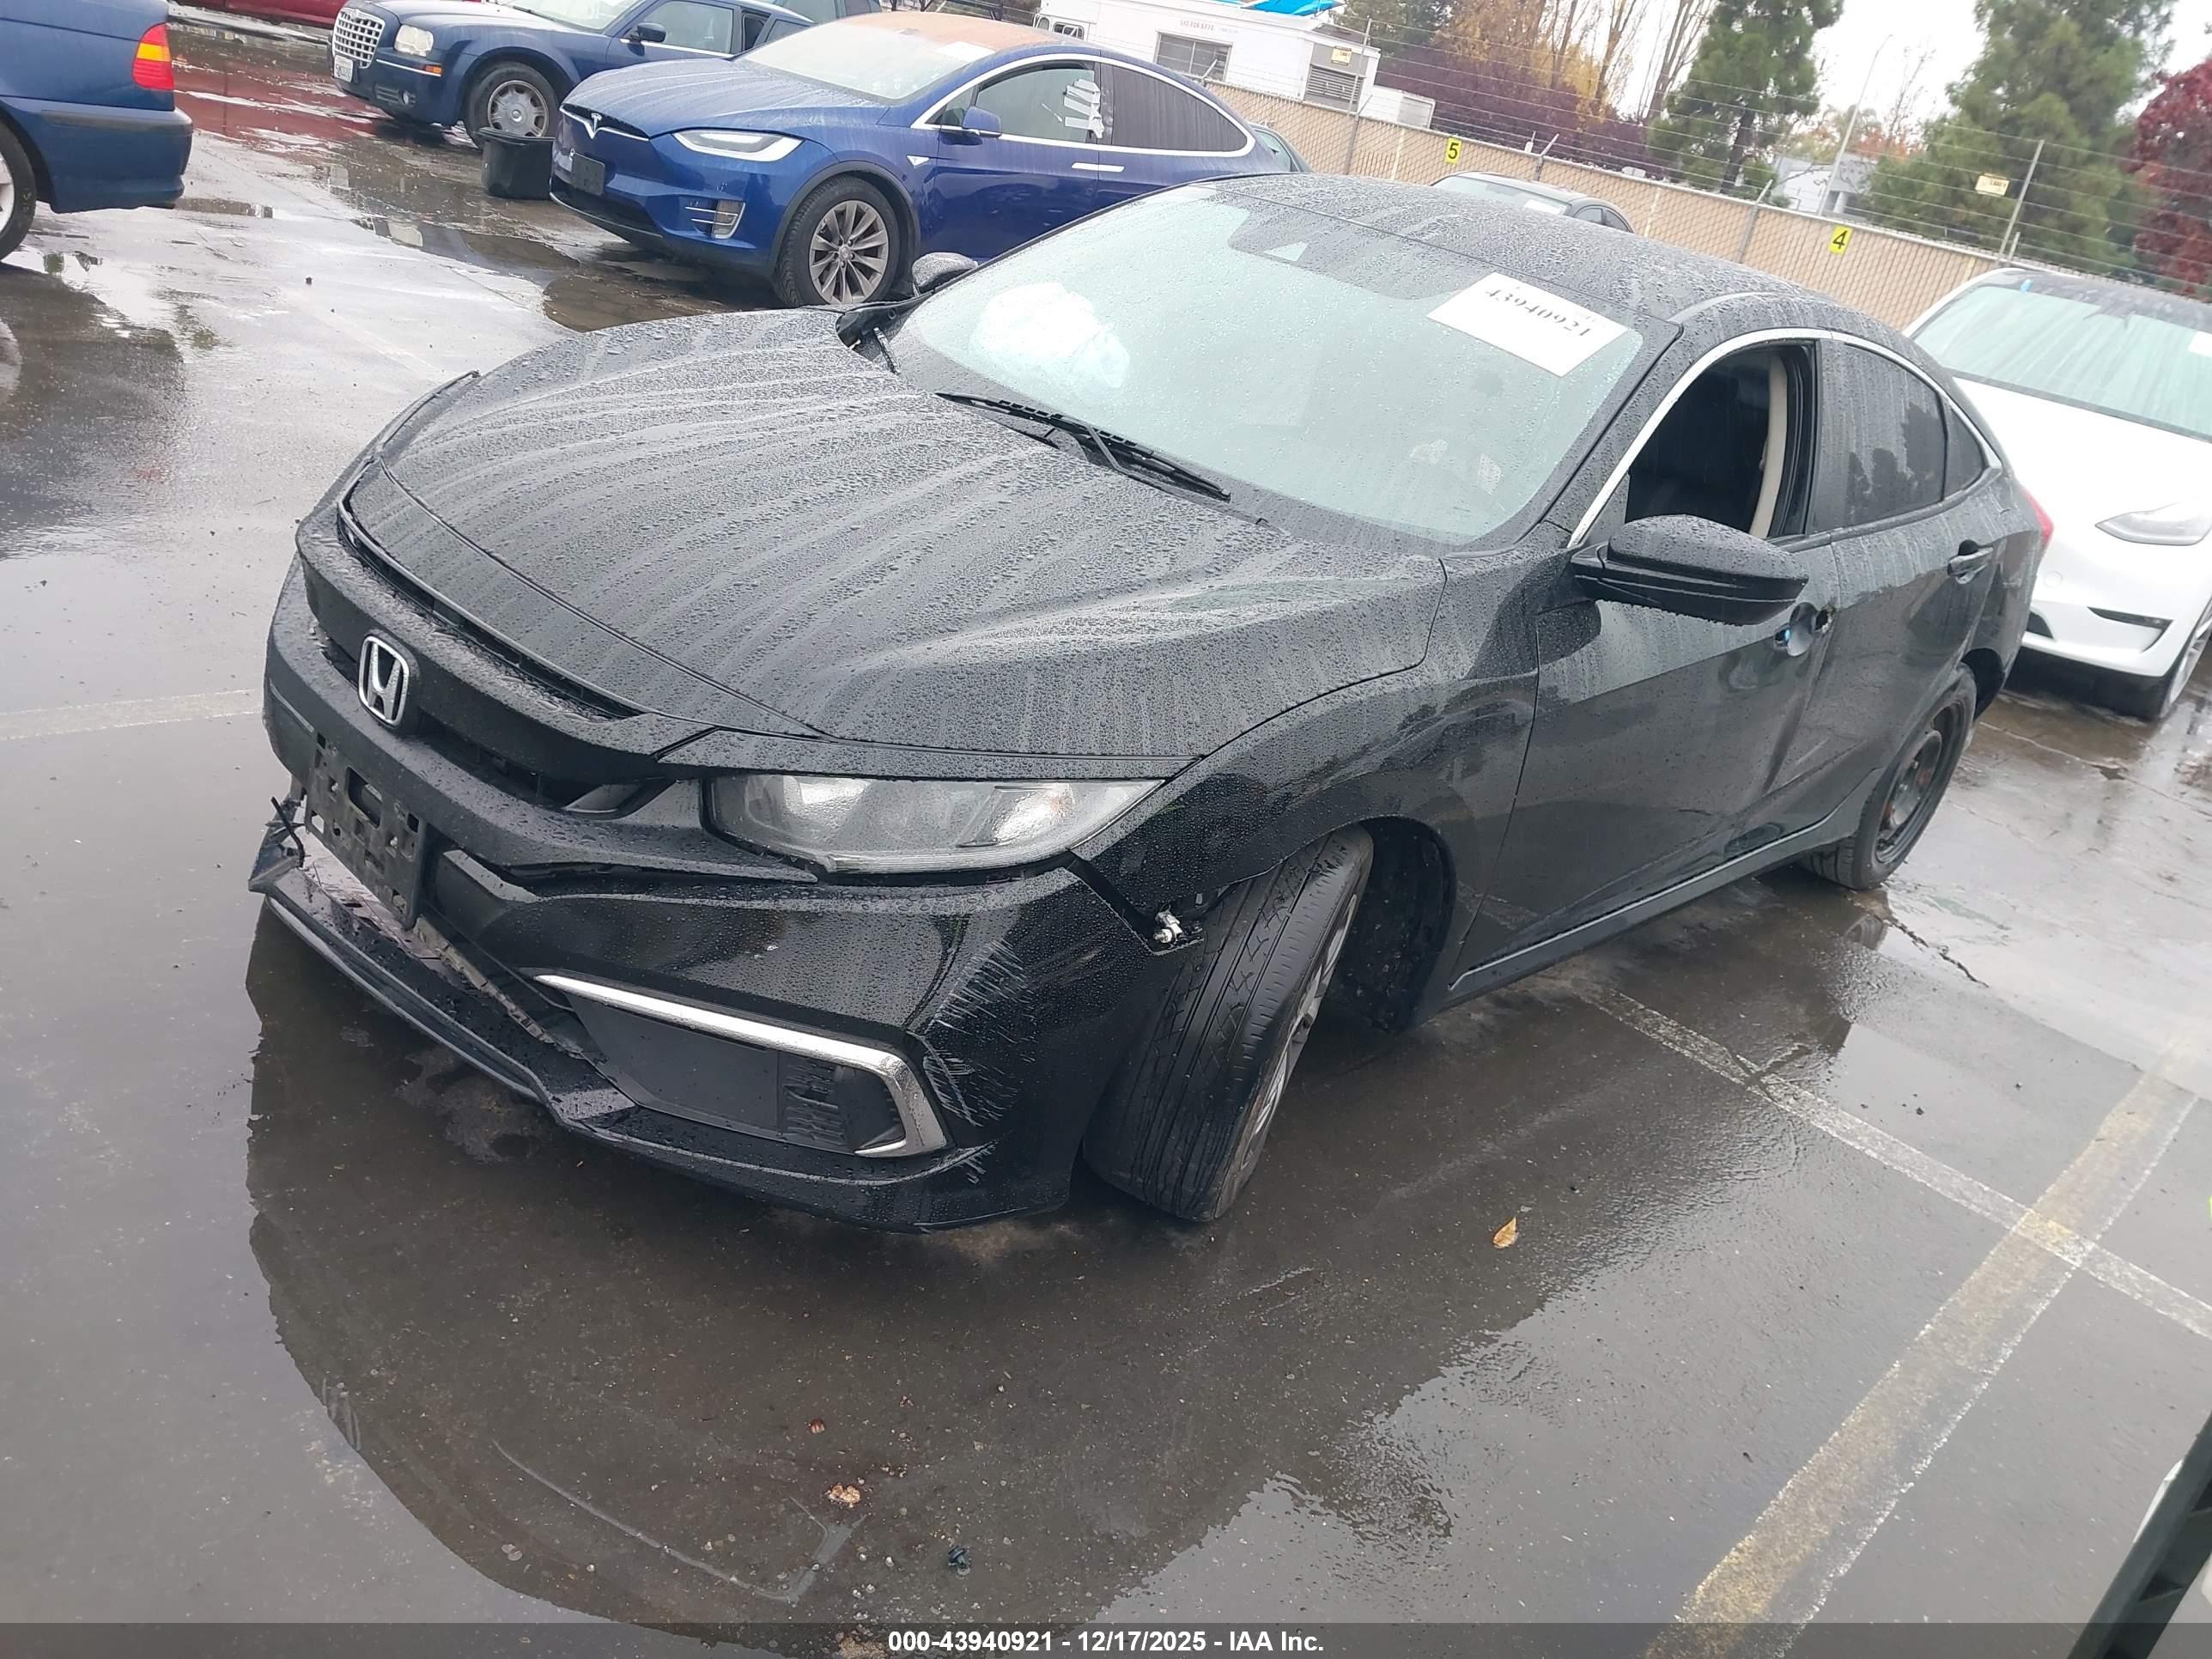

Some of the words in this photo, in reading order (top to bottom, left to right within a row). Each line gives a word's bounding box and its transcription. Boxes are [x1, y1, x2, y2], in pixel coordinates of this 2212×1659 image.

[1448, 142, 1460, 160] 5
[1832, 229, 1848, 250] 4
[1485, 289, 1591, 337] 43940921
